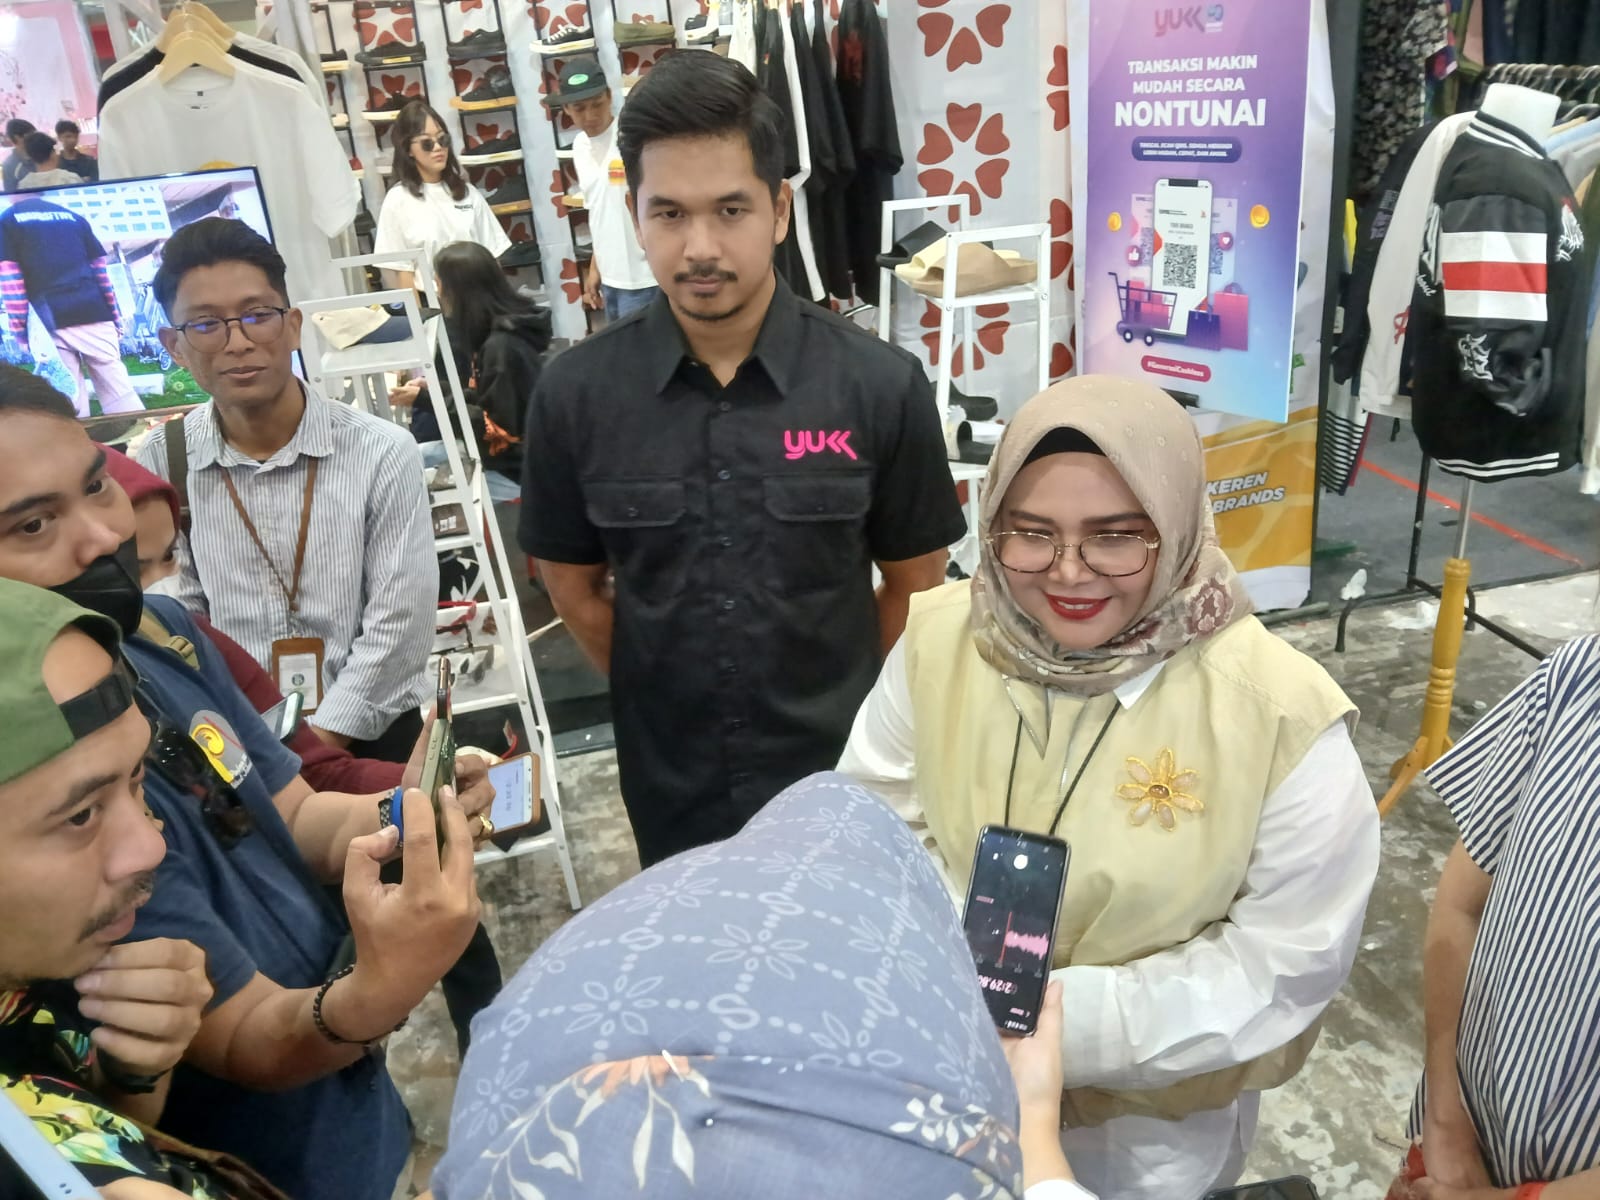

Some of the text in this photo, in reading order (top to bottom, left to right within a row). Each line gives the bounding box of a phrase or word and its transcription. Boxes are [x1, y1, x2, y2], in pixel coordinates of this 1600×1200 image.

[1128, 54, 1258, 74] TRANSAKSI MAKIN
[1132, 77, 1245, 94] MUDAH SECARA
[1114, 98, 1267, 127] NONTUNAI
[1205, 472, 1268, 496] KEREN
[1211, 487, 1285, 514] BRANDS
